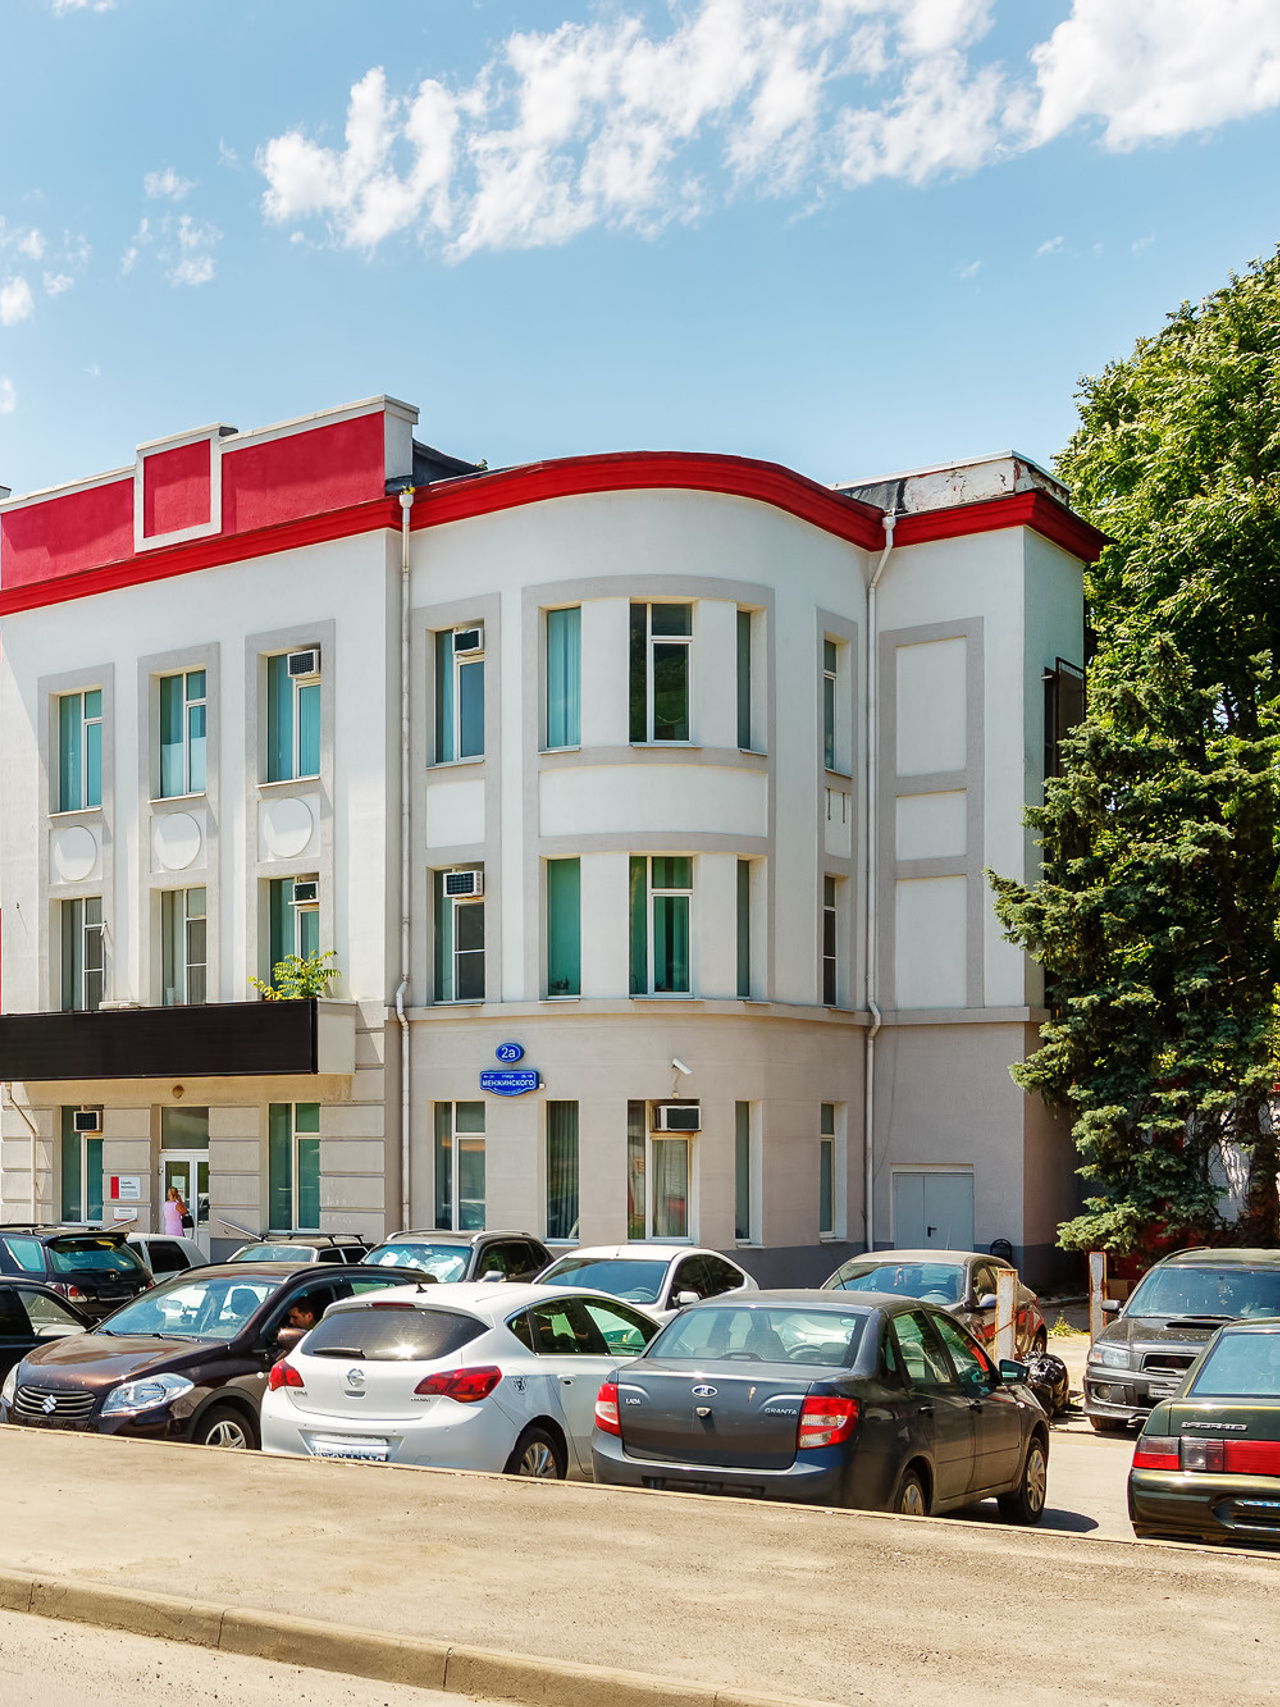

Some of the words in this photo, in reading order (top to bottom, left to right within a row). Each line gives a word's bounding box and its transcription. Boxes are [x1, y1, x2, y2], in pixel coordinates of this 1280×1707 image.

[501, 1047, 516, 1059] 2а
[482, 1079, 534, 1087] МЕНЖИНСКОГО
[625, 1398, 641, 1406] LADA
[764, 1407, 798, 1416] GRANTA
